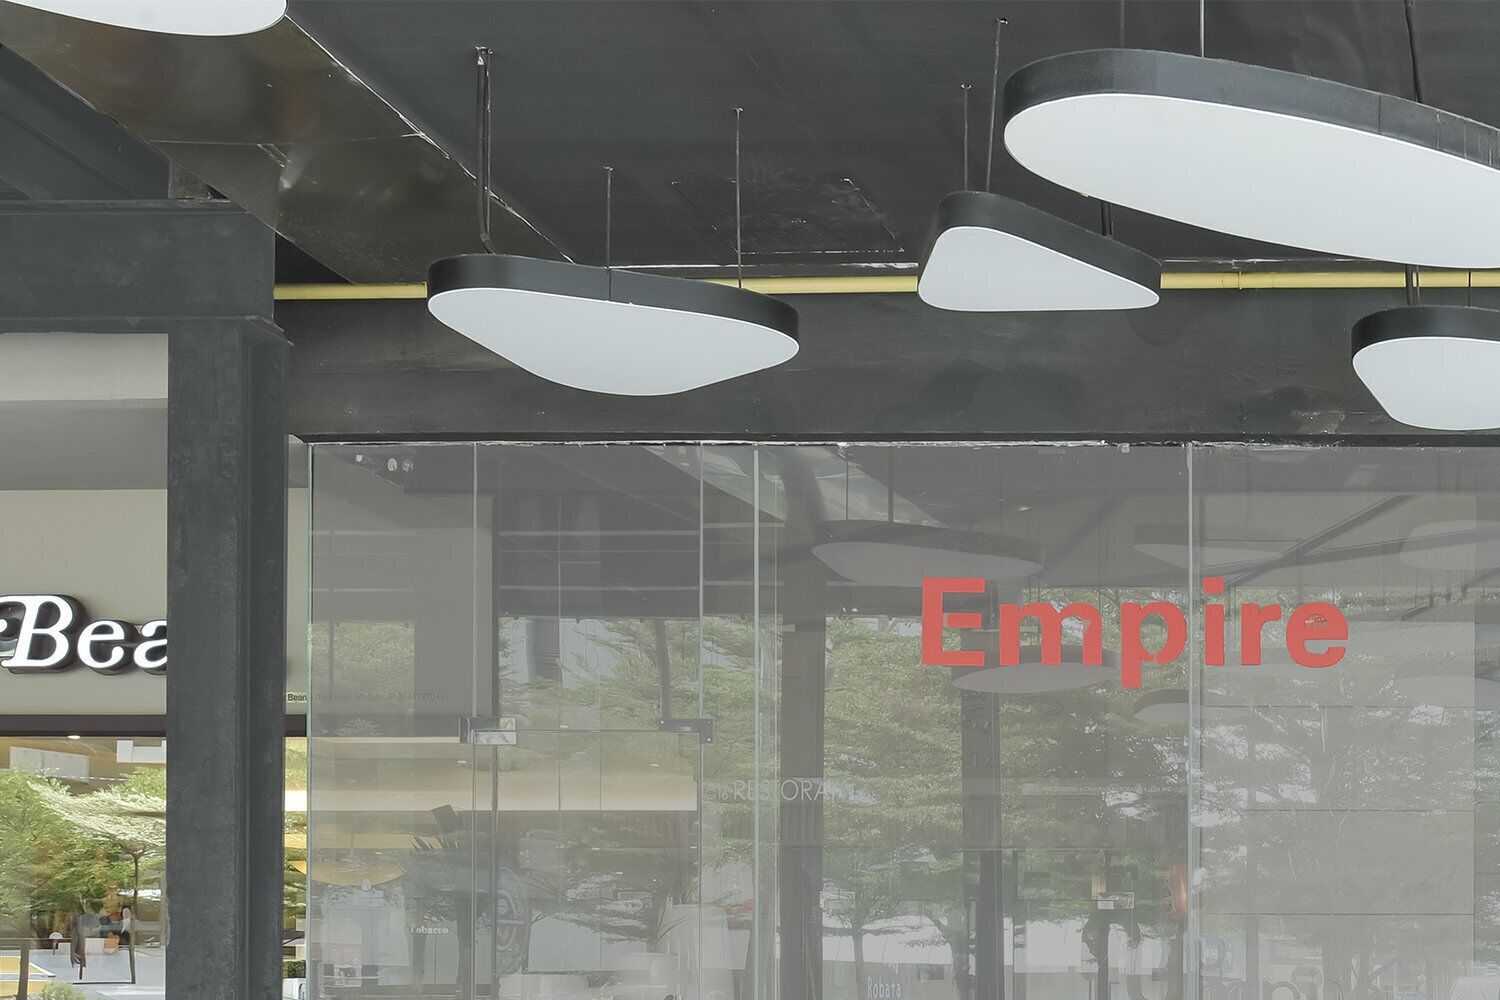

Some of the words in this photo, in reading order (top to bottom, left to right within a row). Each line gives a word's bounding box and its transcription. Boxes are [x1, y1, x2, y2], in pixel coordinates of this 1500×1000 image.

[922, 576, 1349, 689] Empire
[287, 693, 308, 702] Bean
[867, 976, 902, 999] Robata
